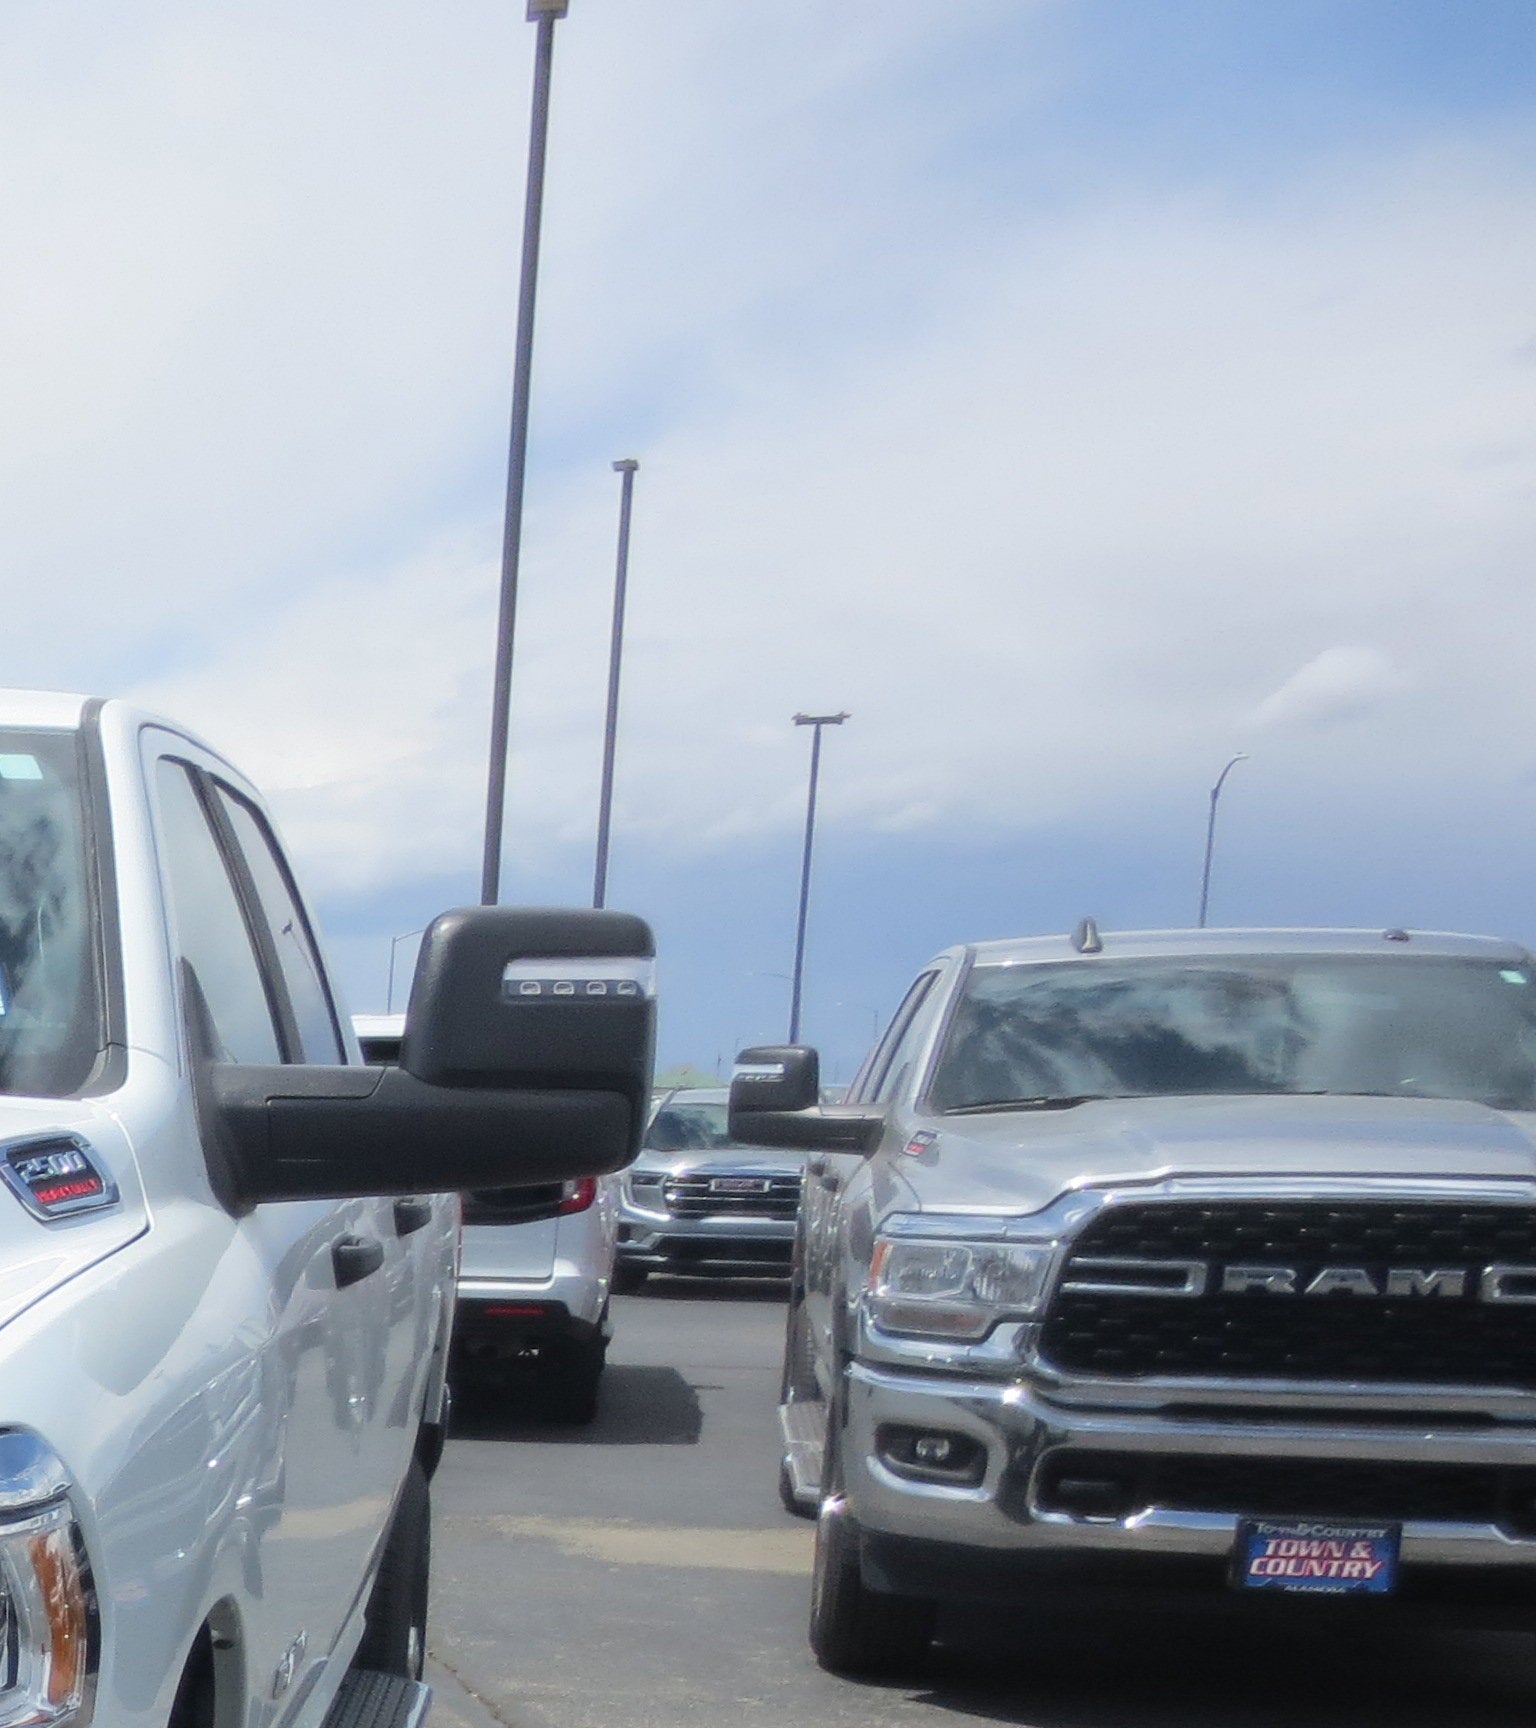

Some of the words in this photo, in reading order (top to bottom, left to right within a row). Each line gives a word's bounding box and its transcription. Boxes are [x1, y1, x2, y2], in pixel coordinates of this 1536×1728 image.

[1222, 1264, 1467, 1298] RAM
[1265, 1539, 1346, 1558] TOWN
[1349, 1540, 1373, 1558] &
[1249, 1557, 1384, 1579] COUNTRY
